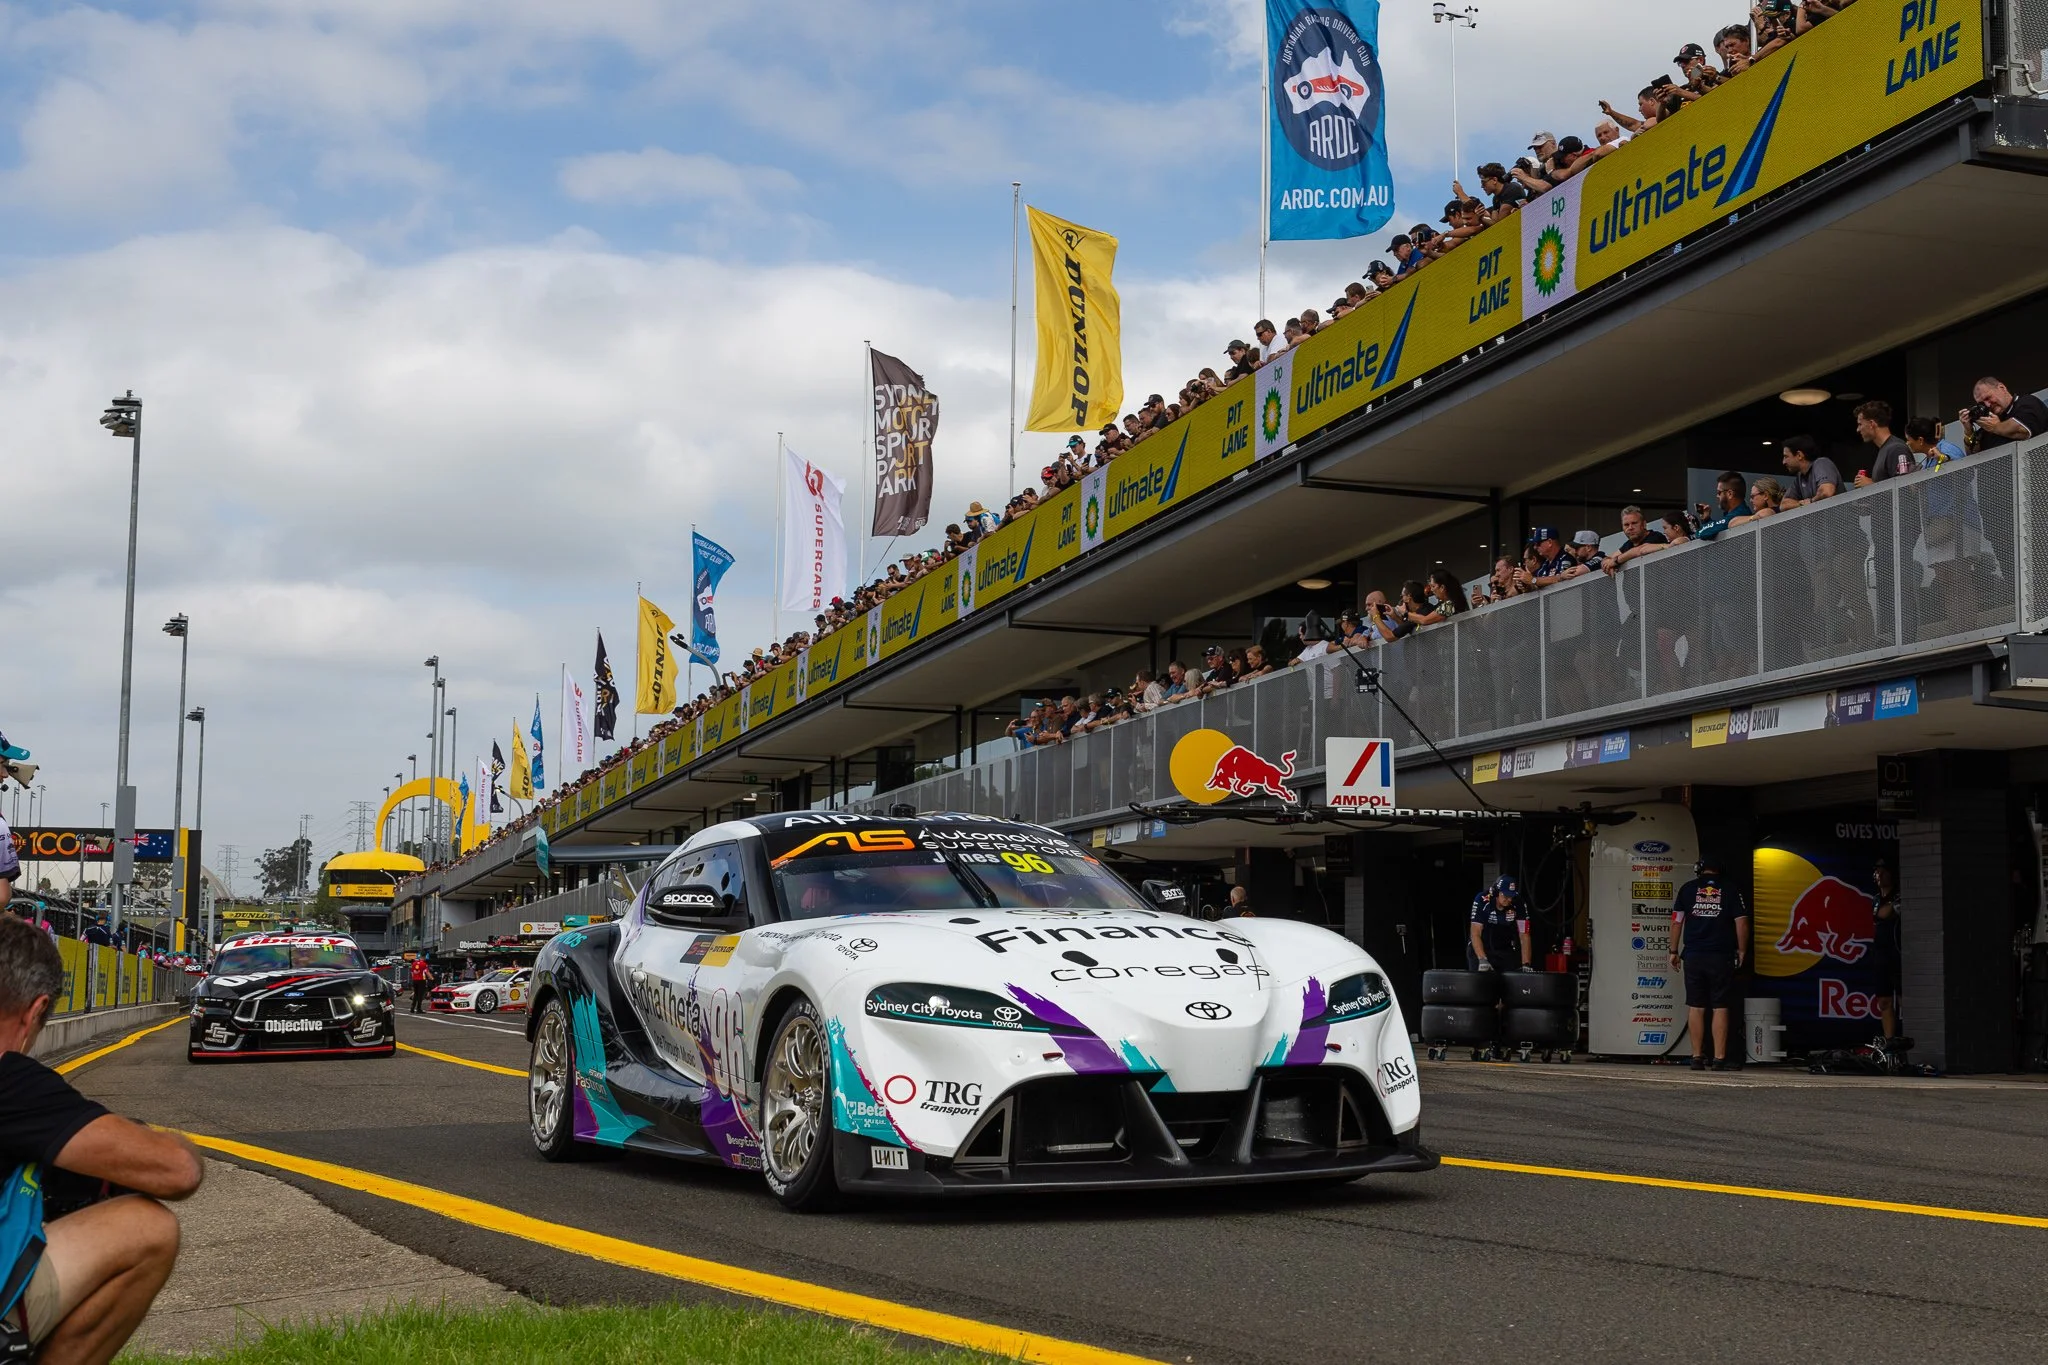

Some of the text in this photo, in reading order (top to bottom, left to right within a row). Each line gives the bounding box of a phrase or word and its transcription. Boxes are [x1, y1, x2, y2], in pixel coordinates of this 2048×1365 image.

[1899, 0, 1938, 43] PIT
[1282, 23, 1305, 66] AUSTRALIAN
[1357, 43, 1371, 67] CLUB
[1885, 21, 1961, 97] LANE
[1309, 114, 1360, 160] ARDC
[1280, 185, 1389, 210] ARDC.COM.AU
[1551, 195, 1565, 218] bp
[1589, 144, 1726, 254] ultimate
[1477, 246, 1503, 286] PIT
[1468, 276, 1512, 325] LANE
[1065, 252, 1090, 427] DUNLOP
[1273, 365, 1283, 383] bp
[1296, 339, 1379, 415] ultimate
[1226, 400, 1244, 429] PIT
[1221, 424, 1249, 460] LANE
[1108, 463, 1164, 519] ultimate
[1061, 502, 1073, 525] PIT
[1057, 523, 1077, 550] LANE
[812, 503, 824, 609] SUPERCARS
[978, 546, 1018, 592] ultimate
[1882, 686, 1912, 707] Thrifty
[1752, 707, 1780, 732] BROWN
[1848, 704, 1863, 716] RACING
[1698, 722, 1727, 734] DUNLOP
[1729, 712, 1749, 735] 888
[1501, 755, 1512, 773] 88
[1516, 751, 1537, 771] FEENEY
[1330, 795, 1391, 807] AMPOL
[918, 827, 1071, 848] Automotive
[1836, 822, 1900, 840] GIVES YOU
[29, 831, 81, 855] 100
[922, 841, 1085, 858] SUPERSTORE
[1640, 841, 1663, 853] Ford
[933, 851, 1055, 874] Jnes 96
[1632, 865, 1673, 873] SUPERCHEAP
[663, 894, 714, 905] sparco
[1638, 904, 1673, 914] Century
[233, 937, 344, 947] Liberty
[459, 940, 488, 949] Objective
[975, 924, 1256, 954] Finance
[835, 944, 859, 961] TOYOTA
[1050, 963, 1270, 982] coregas
[1637, 961, 1668, 969] Partners
[1637, 977, 1667, 989] Thrifty
[866, 999, 983, 1020] Sydney City Toyota
[1332, 990, 1386, 1015] Sydney City Toyota
[264, 1019, 323, 1034] Objective
[991, 1020, 1024, 1030] TOYOTA
[710, 988, 749, 1106] 96
[924, 1080, 983, 1107] TRG
[857, 1101, 886, 1117] Beta
[920, 1101, 980, 1116] transport
[740, 1152, 761, 1169] Repco
